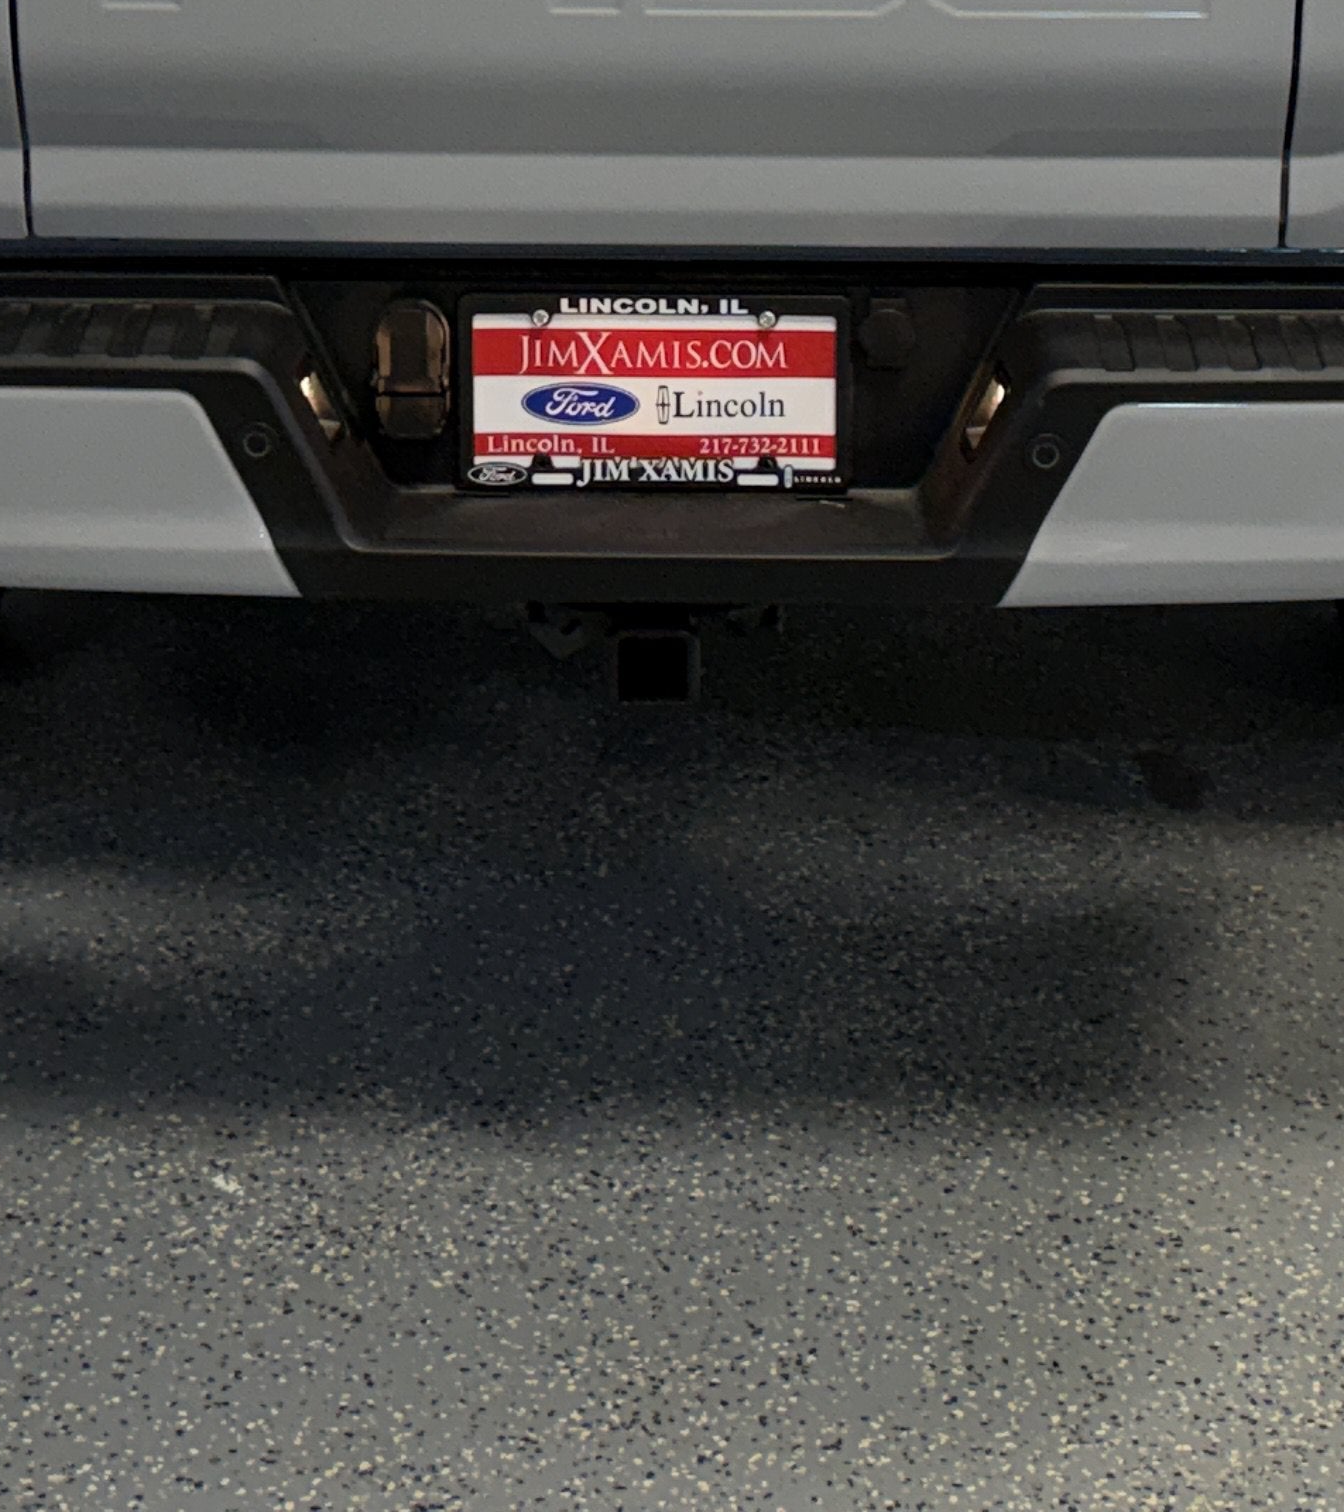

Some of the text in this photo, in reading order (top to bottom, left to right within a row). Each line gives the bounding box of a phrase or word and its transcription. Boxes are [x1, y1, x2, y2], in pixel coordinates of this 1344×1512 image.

[560, 297, 749, 316] LINCOLN, IL
[519, 331, 789, 376] JIMXAMIS.COM
[544, 387, 616, 418] Ford
[672, 390, 785, 419] Lincoln
[487, 434, 616, 455] Lincoln, IL
[699, 437, 821, 455] 217-732-2111
[479, 466, 517, 483] Ford
[576, 458, 735, 487] JIM XAMIS
